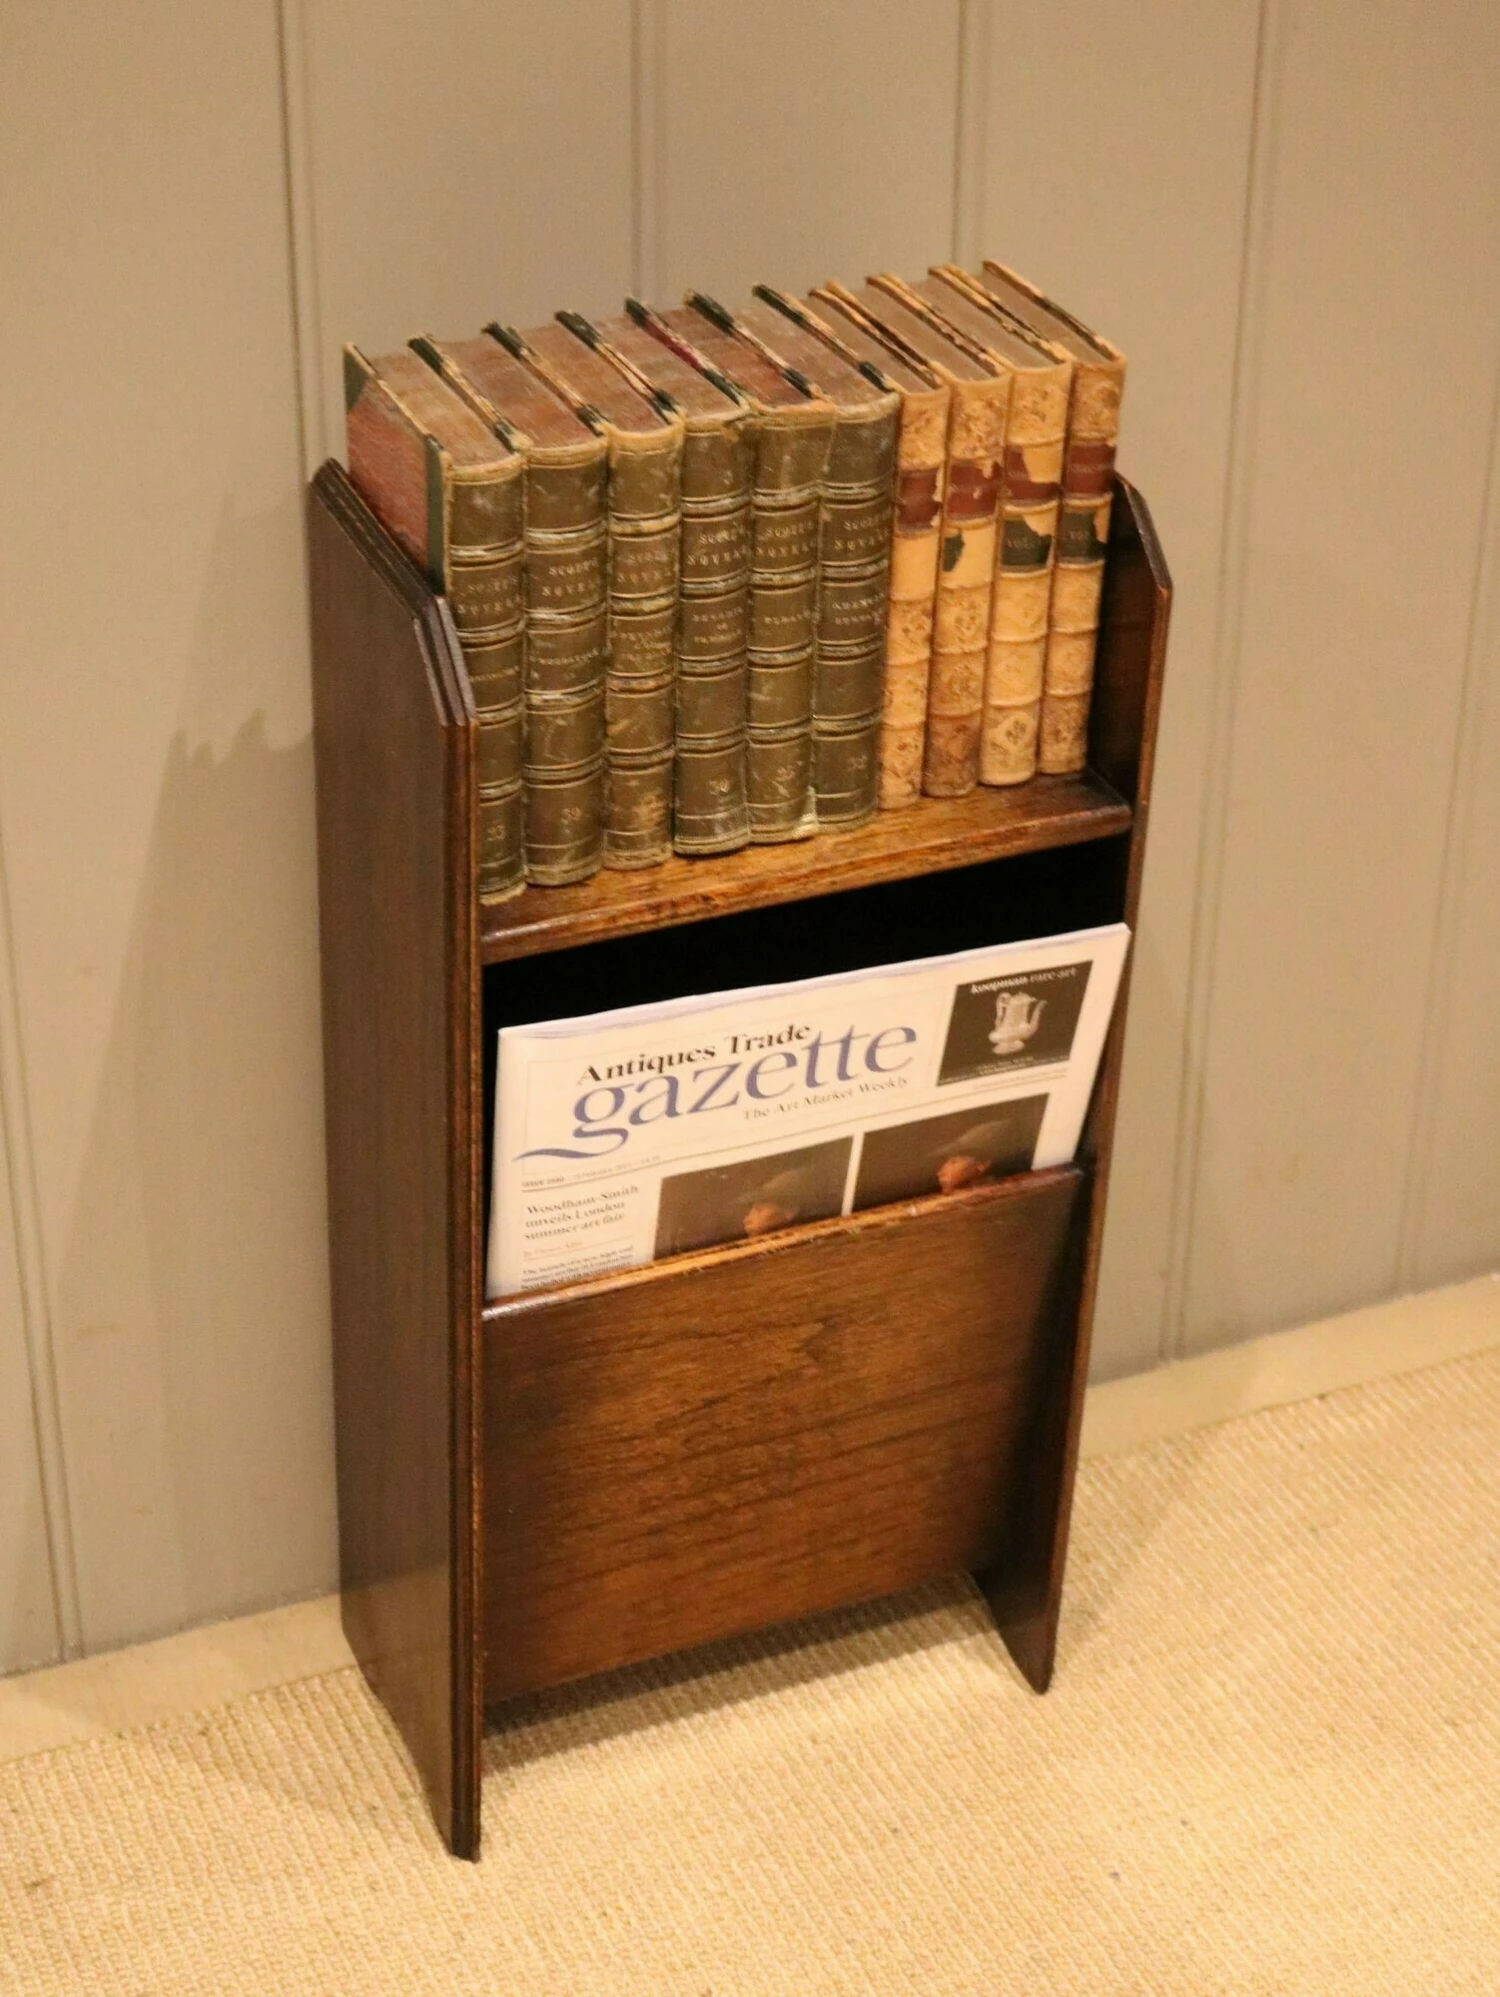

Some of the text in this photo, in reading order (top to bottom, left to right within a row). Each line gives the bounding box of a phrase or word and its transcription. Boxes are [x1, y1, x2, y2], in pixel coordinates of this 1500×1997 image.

[576, 1024, 812, 1086] Antiques Trade
[512, 1024, 918, 1161] gazette
[743, 1076, 909, 1120] The Art Market Weekly
[524, 1201, 626, 1229] unveils London
[526, 1185, 640, 1215] Woodham-Smith
[523, 1212, 626, 1240] summer art fair
